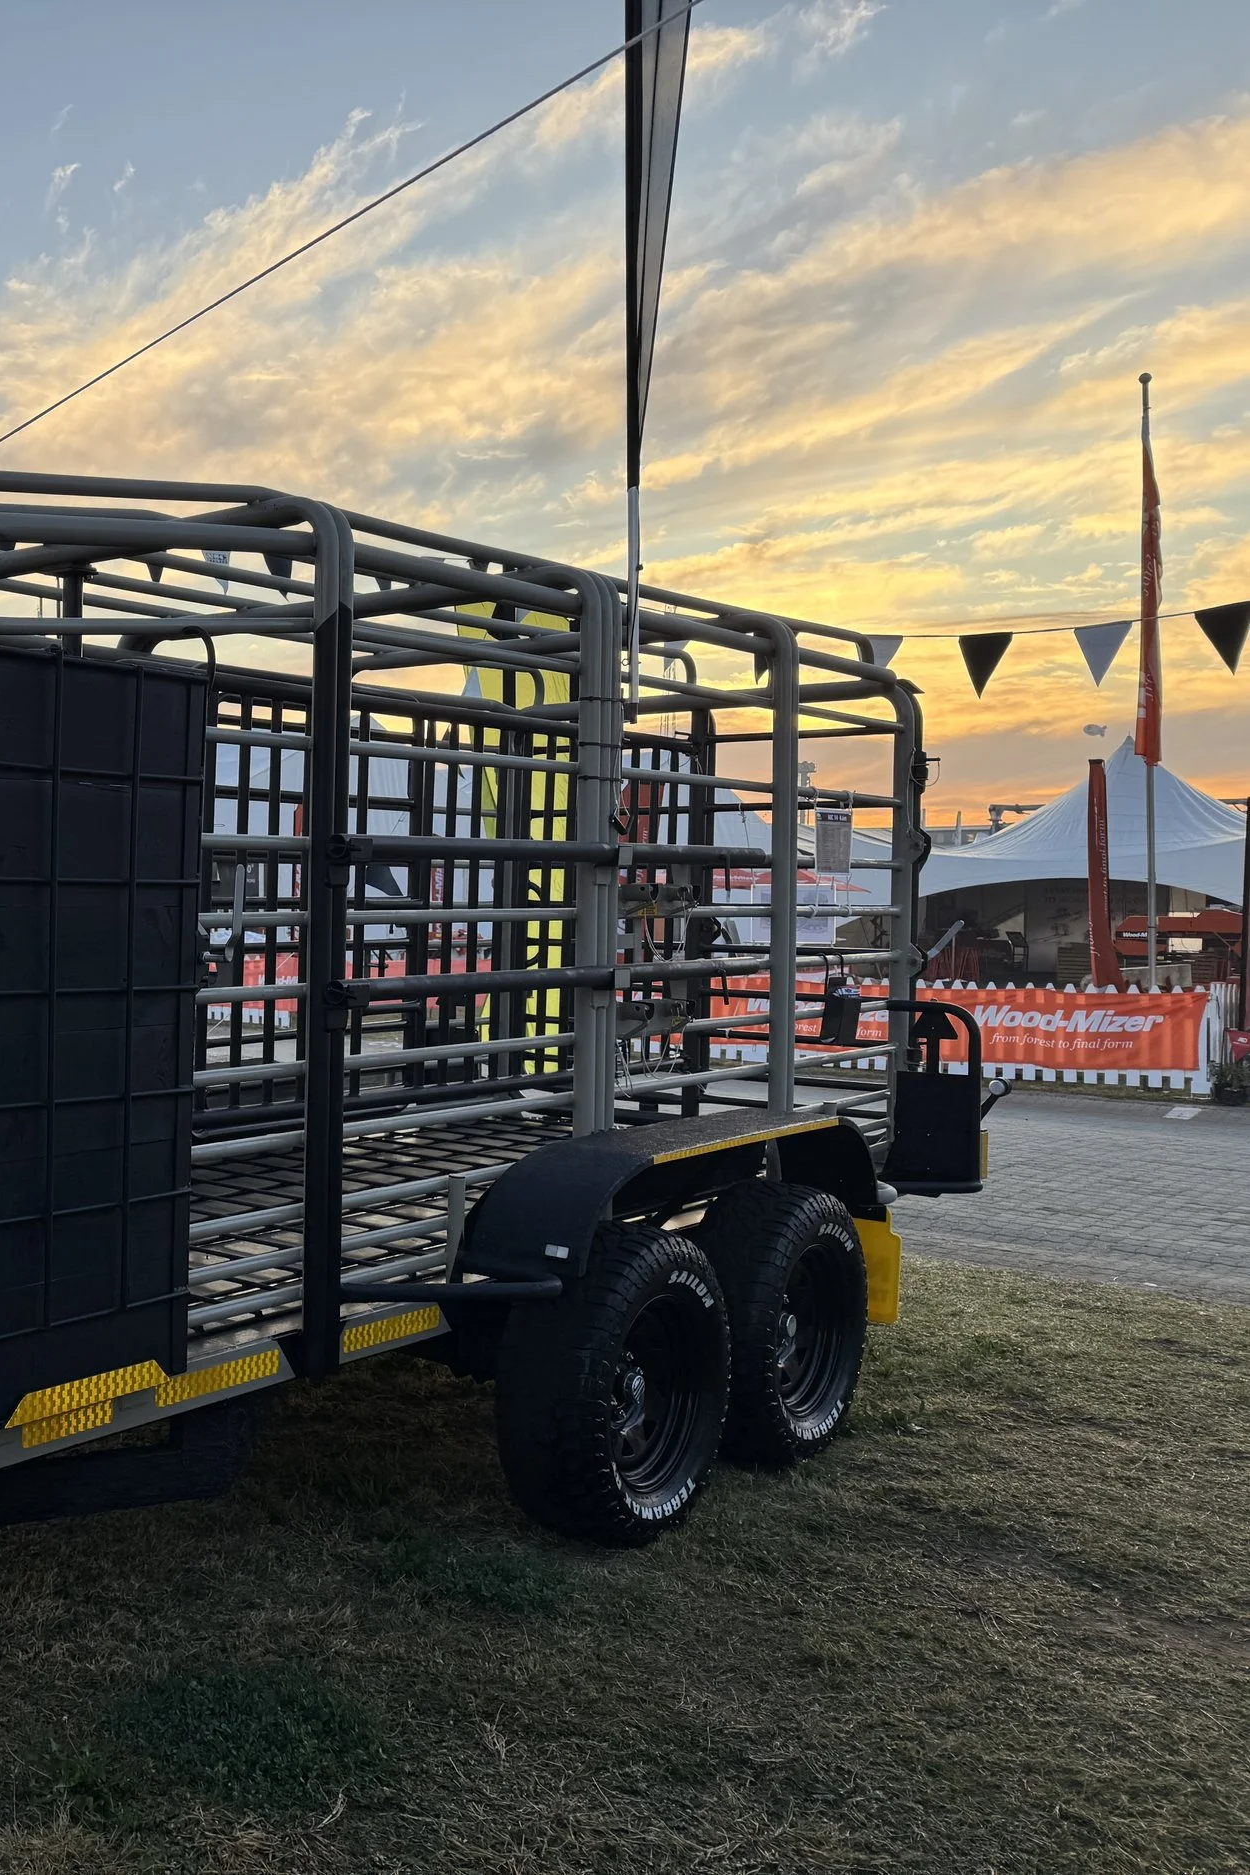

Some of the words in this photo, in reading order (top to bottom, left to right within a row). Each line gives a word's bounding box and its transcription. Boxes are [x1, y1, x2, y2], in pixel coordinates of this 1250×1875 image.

[973, 1005, 1163, 1033] Wood-Mizer
[989, 1032, 1020, 1045] from
[1020, 1033, 1058, 1049] forest
[1058, 1039, 1069, 1049] to
[1070, 1038, 1100, 1051] final
[1100, 1039, 1133, 1051] form
[817, 1222, 854, 1252] SAILUN
[667, 1270, 713, 1309] SAILUN
[789, 1399, 845, 1441] TERRAMAX
[623, 1477, 696, 1520] TERRAMAX
